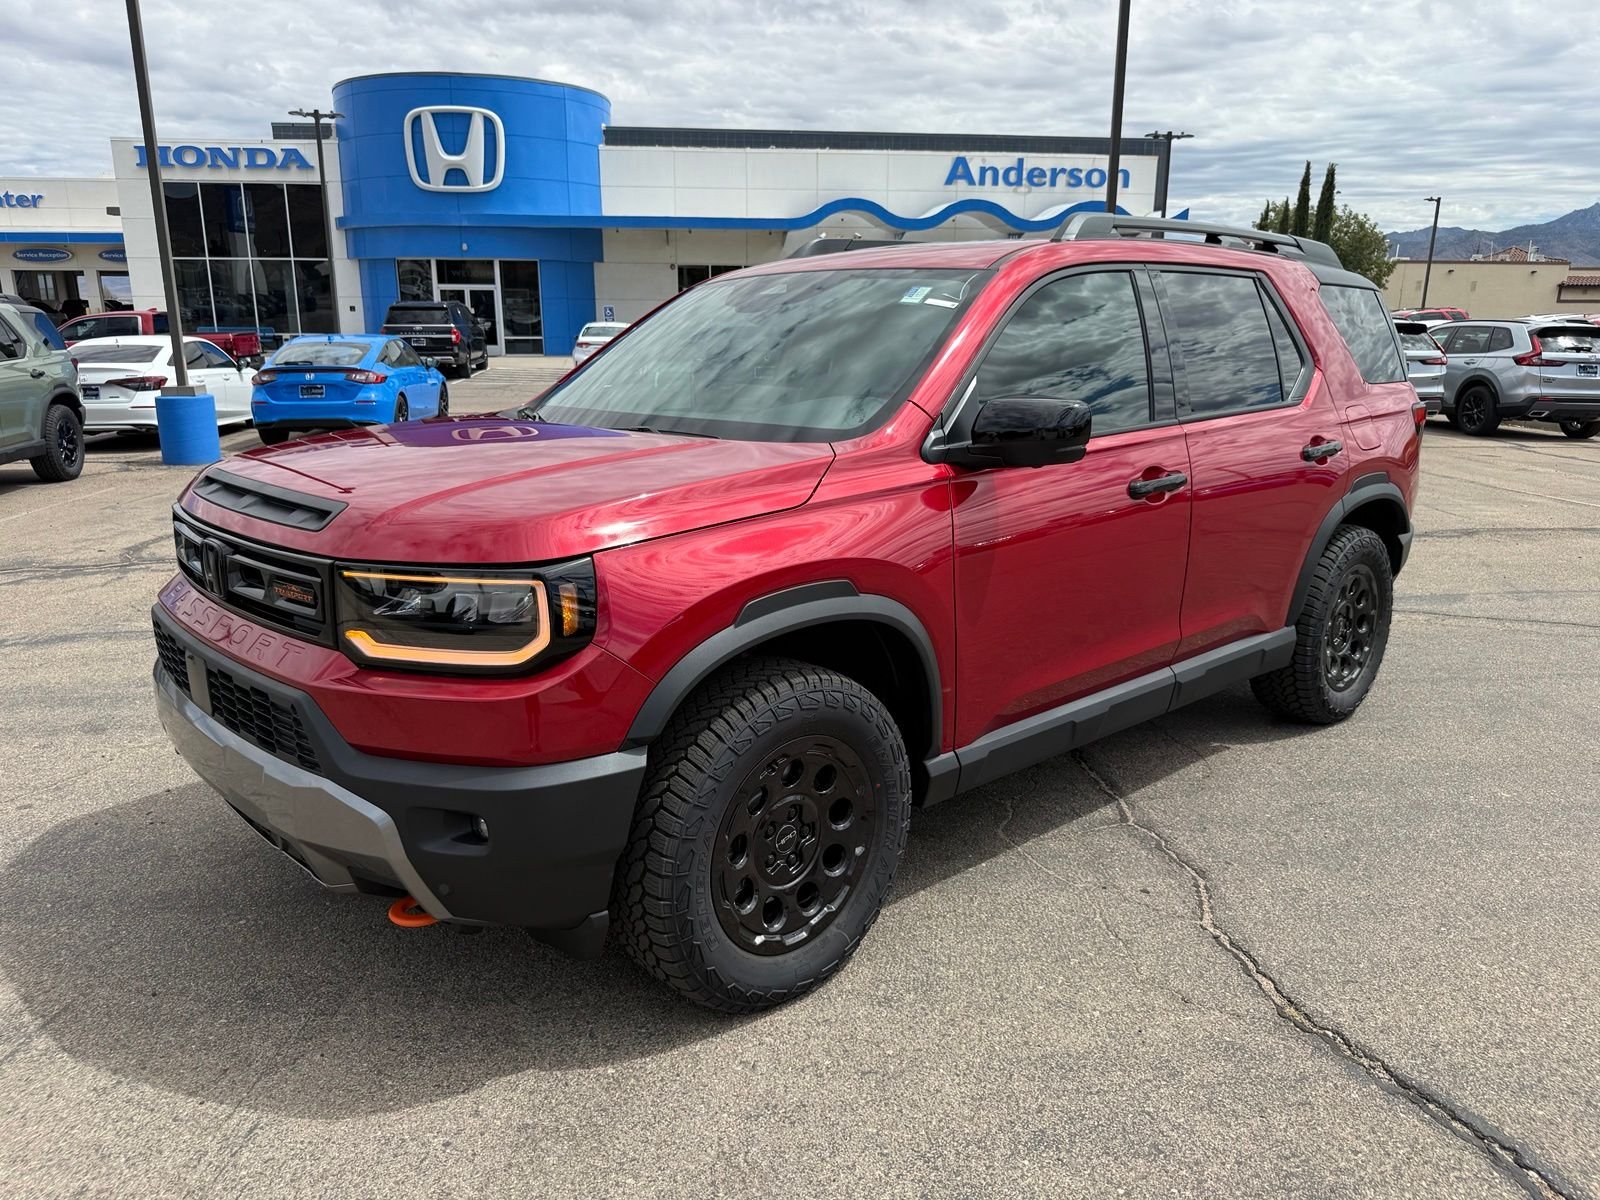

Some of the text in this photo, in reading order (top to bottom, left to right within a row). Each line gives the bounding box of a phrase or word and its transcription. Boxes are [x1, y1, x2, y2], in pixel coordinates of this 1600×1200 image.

[133, 145, 314, 170] HONDA
[0, 190, 44, 208] ter
[39, 252, 68, 260] Reception
